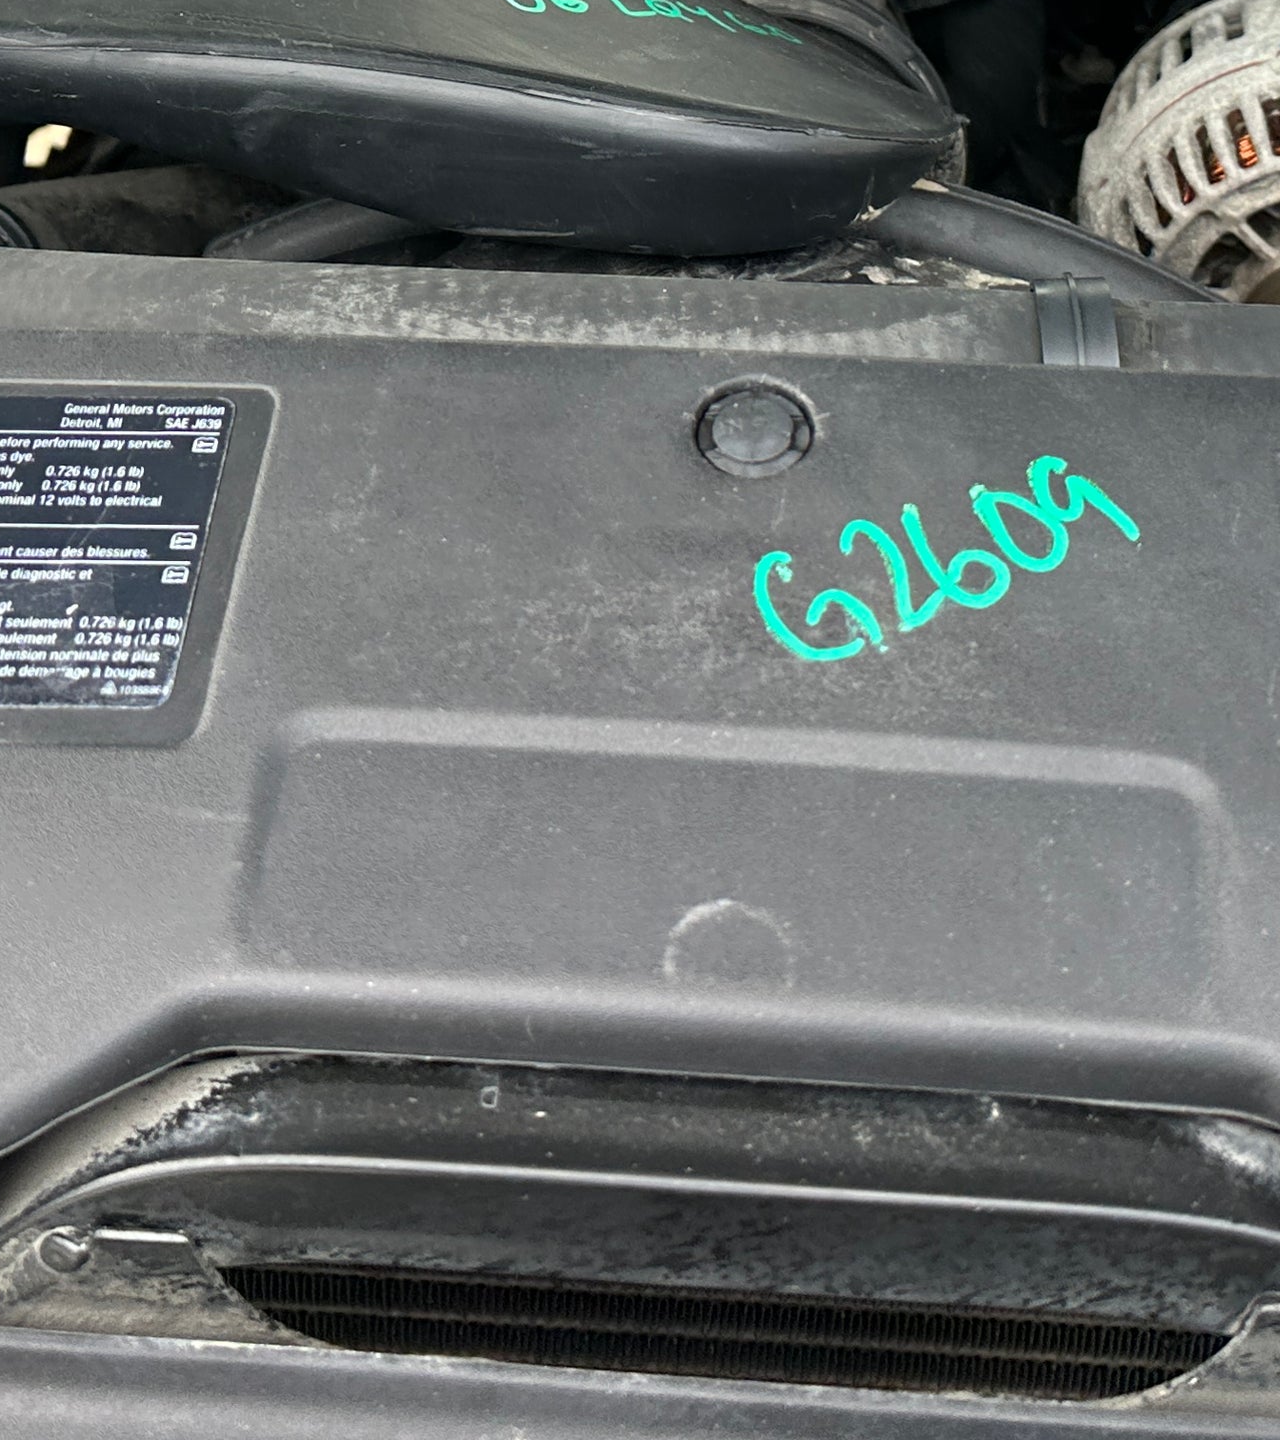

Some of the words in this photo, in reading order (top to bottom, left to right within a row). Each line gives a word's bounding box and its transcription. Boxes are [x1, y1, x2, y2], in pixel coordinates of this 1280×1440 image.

[64, 403, 111, 414] General
[112, 403, 154, 415] Motors
[156, 404, 225, 418] Corporation
[107, 417, 123, 428] MI
[165, 416, 189, 429] SAE
[191, 418, 222, 430] J639
[32, 437, 100, 451] performing
[102, 439, 125, 451] any
[753, 455, 1143, 662] G2609
